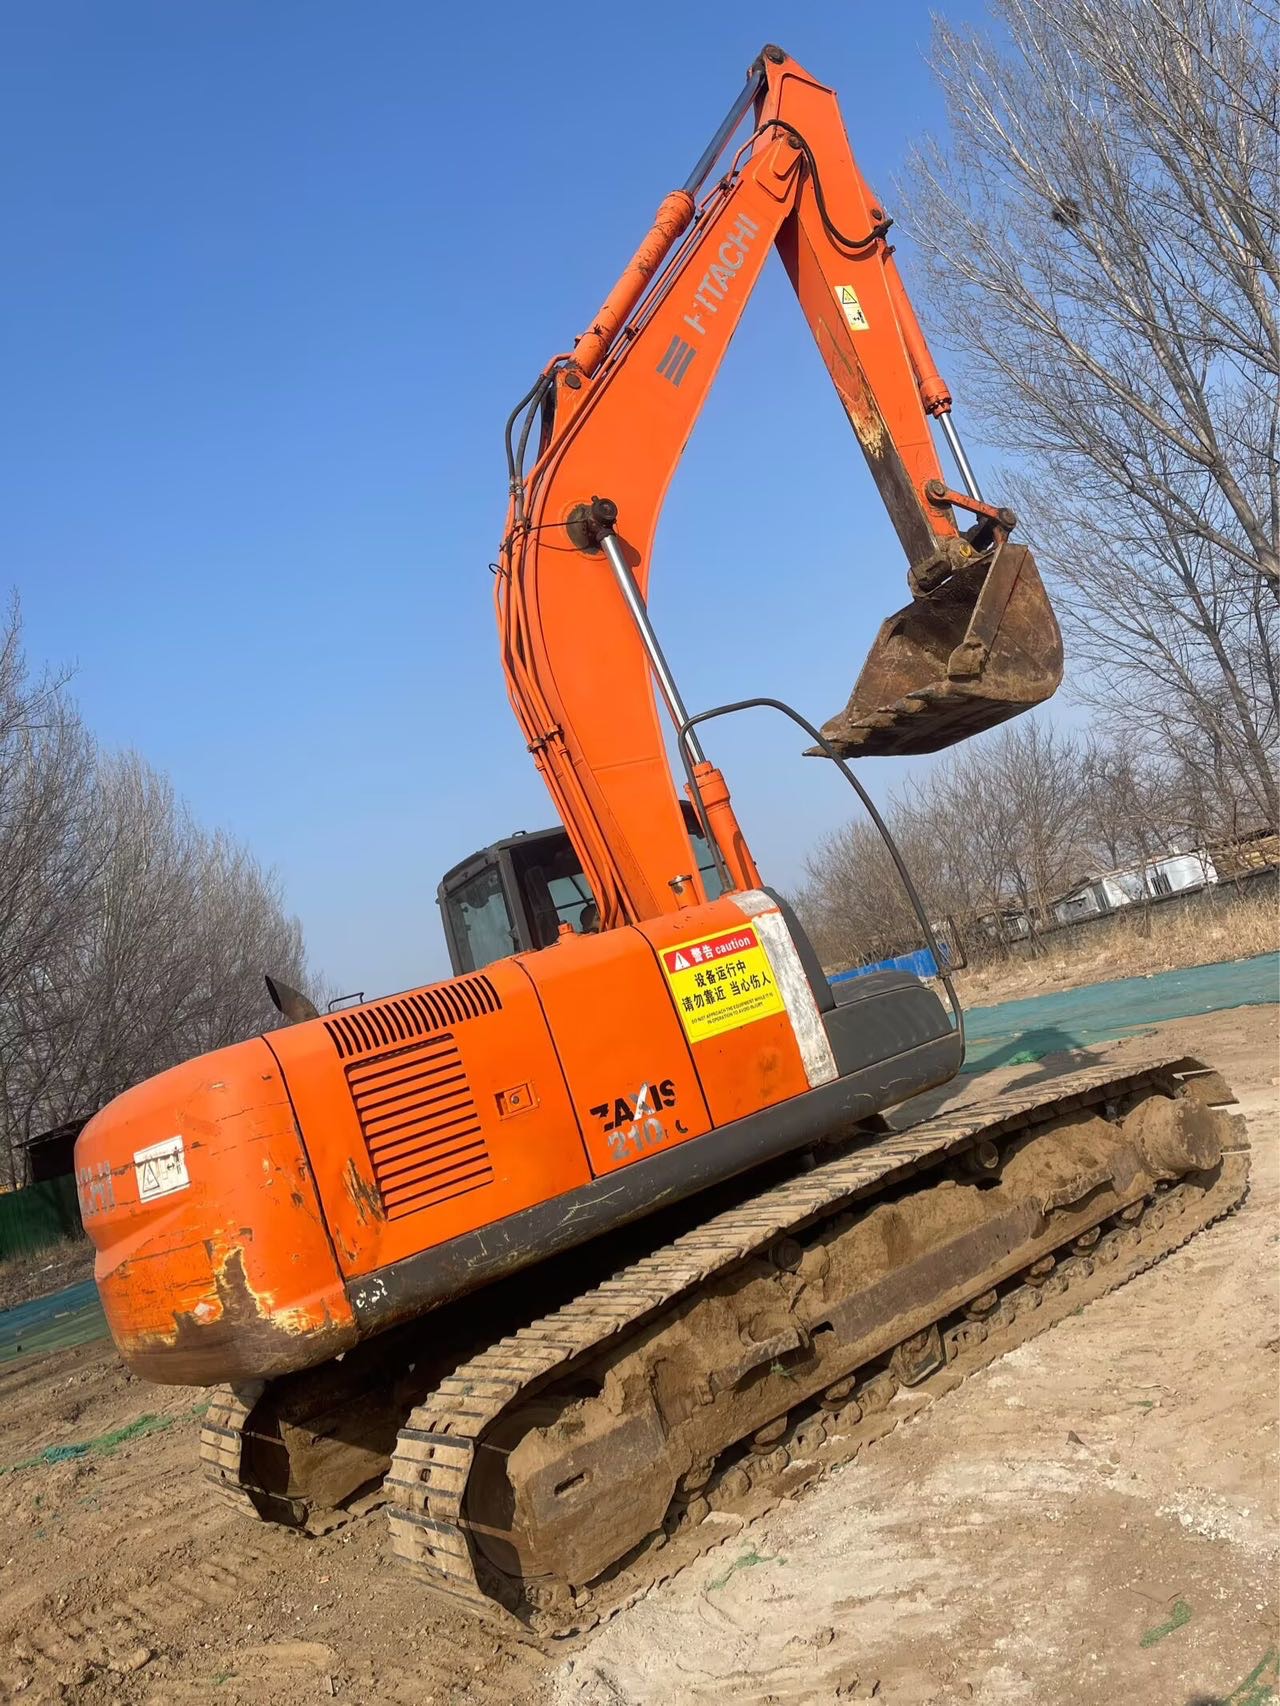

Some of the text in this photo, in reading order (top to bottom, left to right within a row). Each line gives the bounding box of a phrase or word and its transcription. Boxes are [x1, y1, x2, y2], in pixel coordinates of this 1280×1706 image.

[683, 212, 760, 335] HITACHI
[690, 937, 751, 963] 警告 caution
[682, 971, 771, 1012] 请勿靠近 当心伤人
[694, 959, 746, 988] 设备运行中
[607, 1117, 664, 1161] 210
